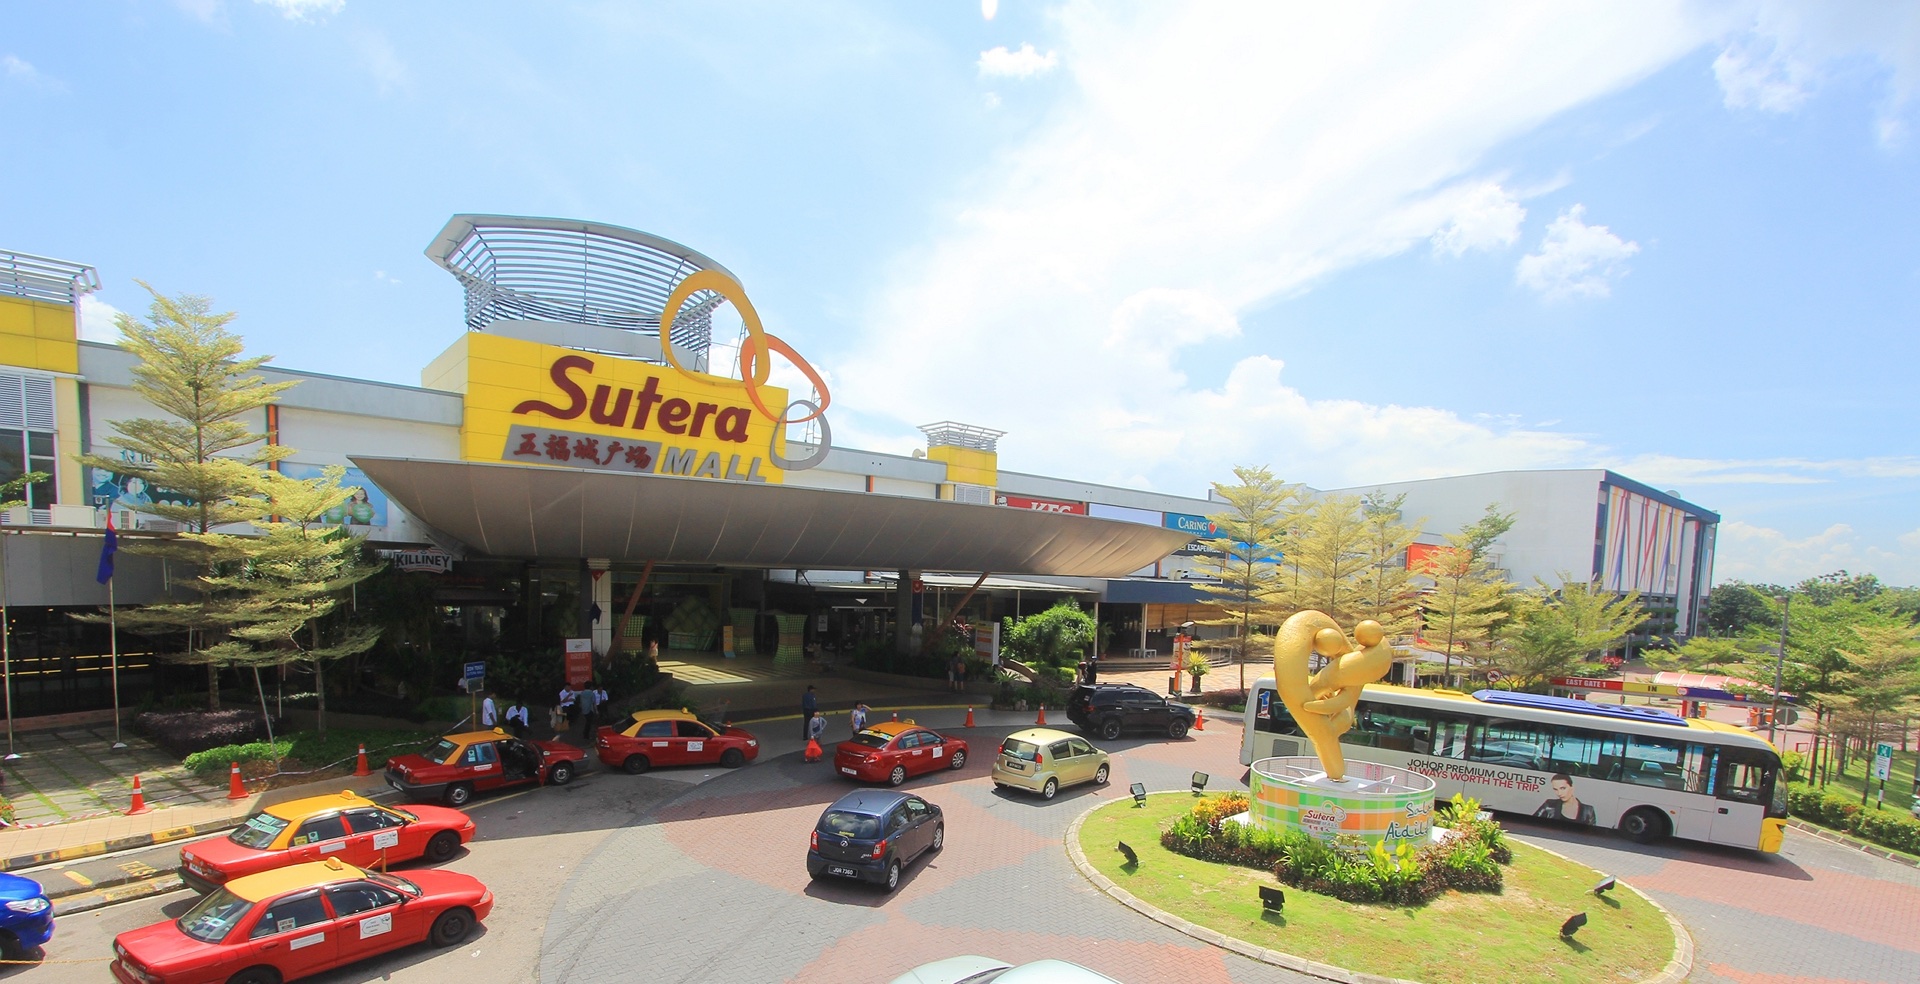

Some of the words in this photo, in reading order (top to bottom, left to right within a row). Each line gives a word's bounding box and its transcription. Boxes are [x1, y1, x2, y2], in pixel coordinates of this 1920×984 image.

[511, 354, 752, 444] Sutera
[513, 432, 651, 470] 五福城广场
[661, 446, 767, 483] MALL
[395, 554, 450, 568] KILLINEY
[1565, 678, 1582, 686] EAST
[1583, 680, 1601, 688] GATE
[1407, 759, 1444, 771] JOHOR
[1445, 763, 1495, 778] PREMIUM
[1497, 771, 1546, 785] OUTLETS
[1450, 772, 1491, 786] WORTH
[1493, 778, 1513, 789] THE
[1515, 781, 1541, 793] TRIP.
[1304, 810, 1335, 821] Sutera
